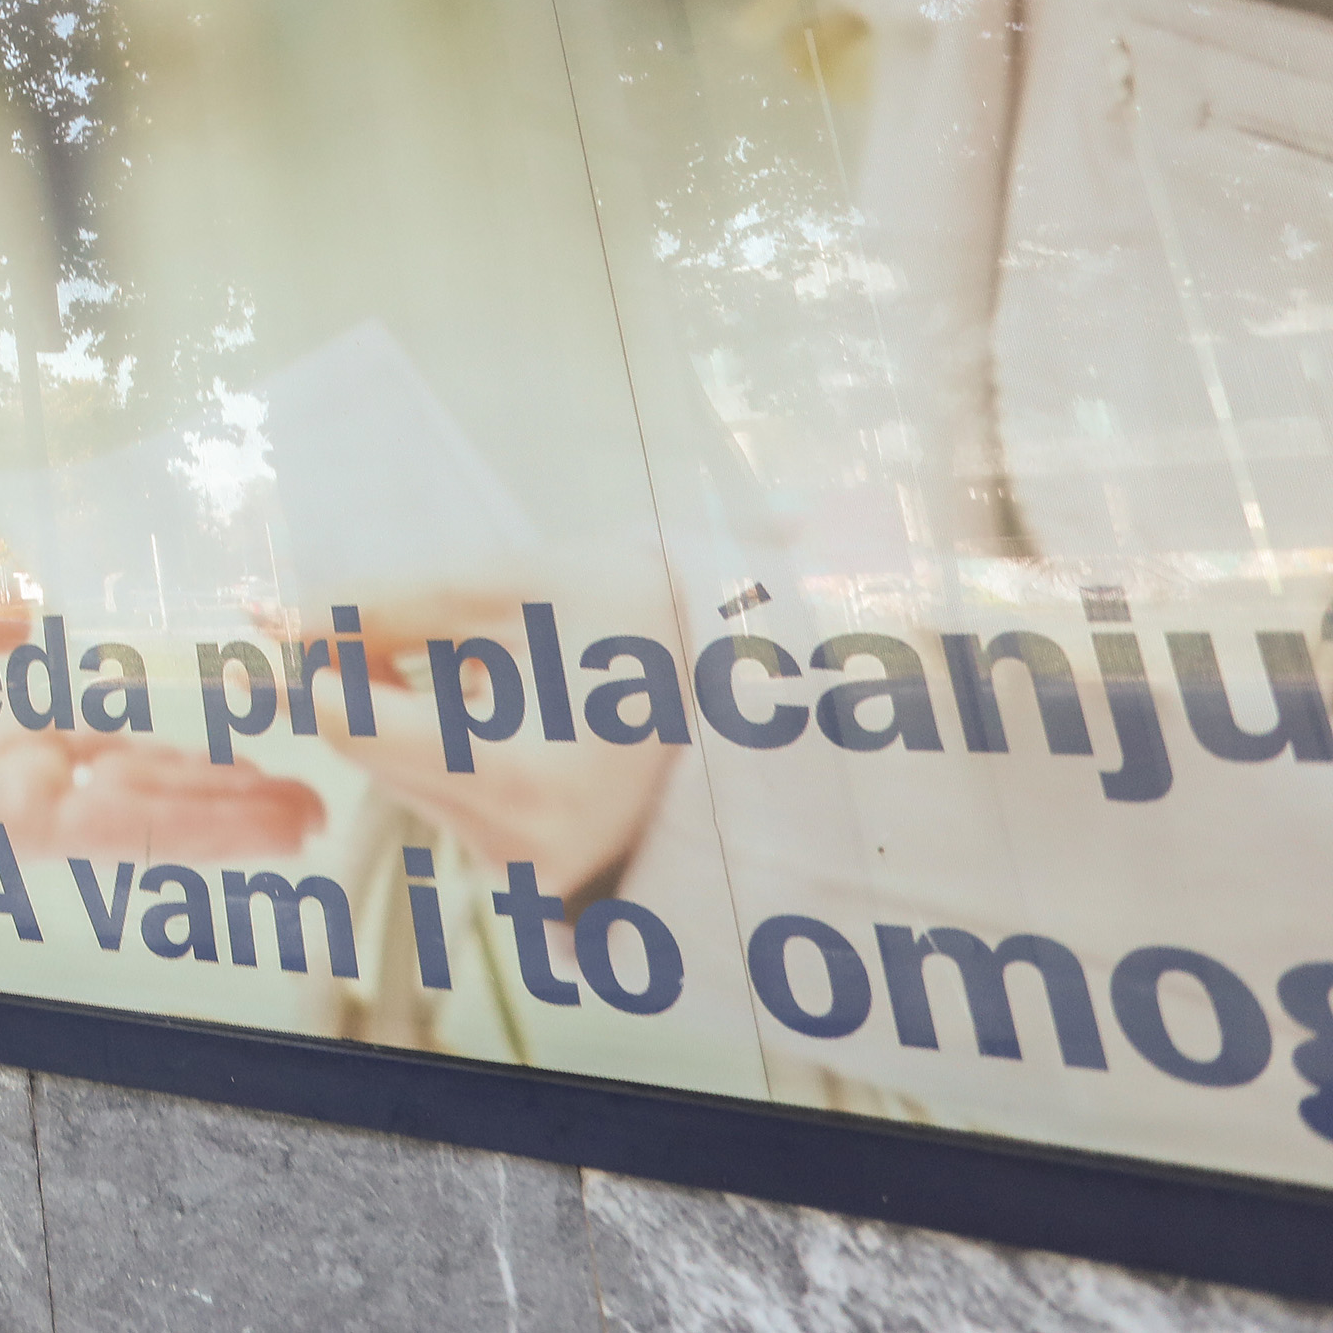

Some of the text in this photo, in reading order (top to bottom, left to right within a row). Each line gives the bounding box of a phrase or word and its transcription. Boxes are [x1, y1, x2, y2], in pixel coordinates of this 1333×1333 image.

[195, 604, 378, 766] pri
[425, 581, 1333, 804] plaćanju
[66, 856, 360, 980] vam
[401, 845, 453, 991] i
[493, 860, 685, 1017] to
